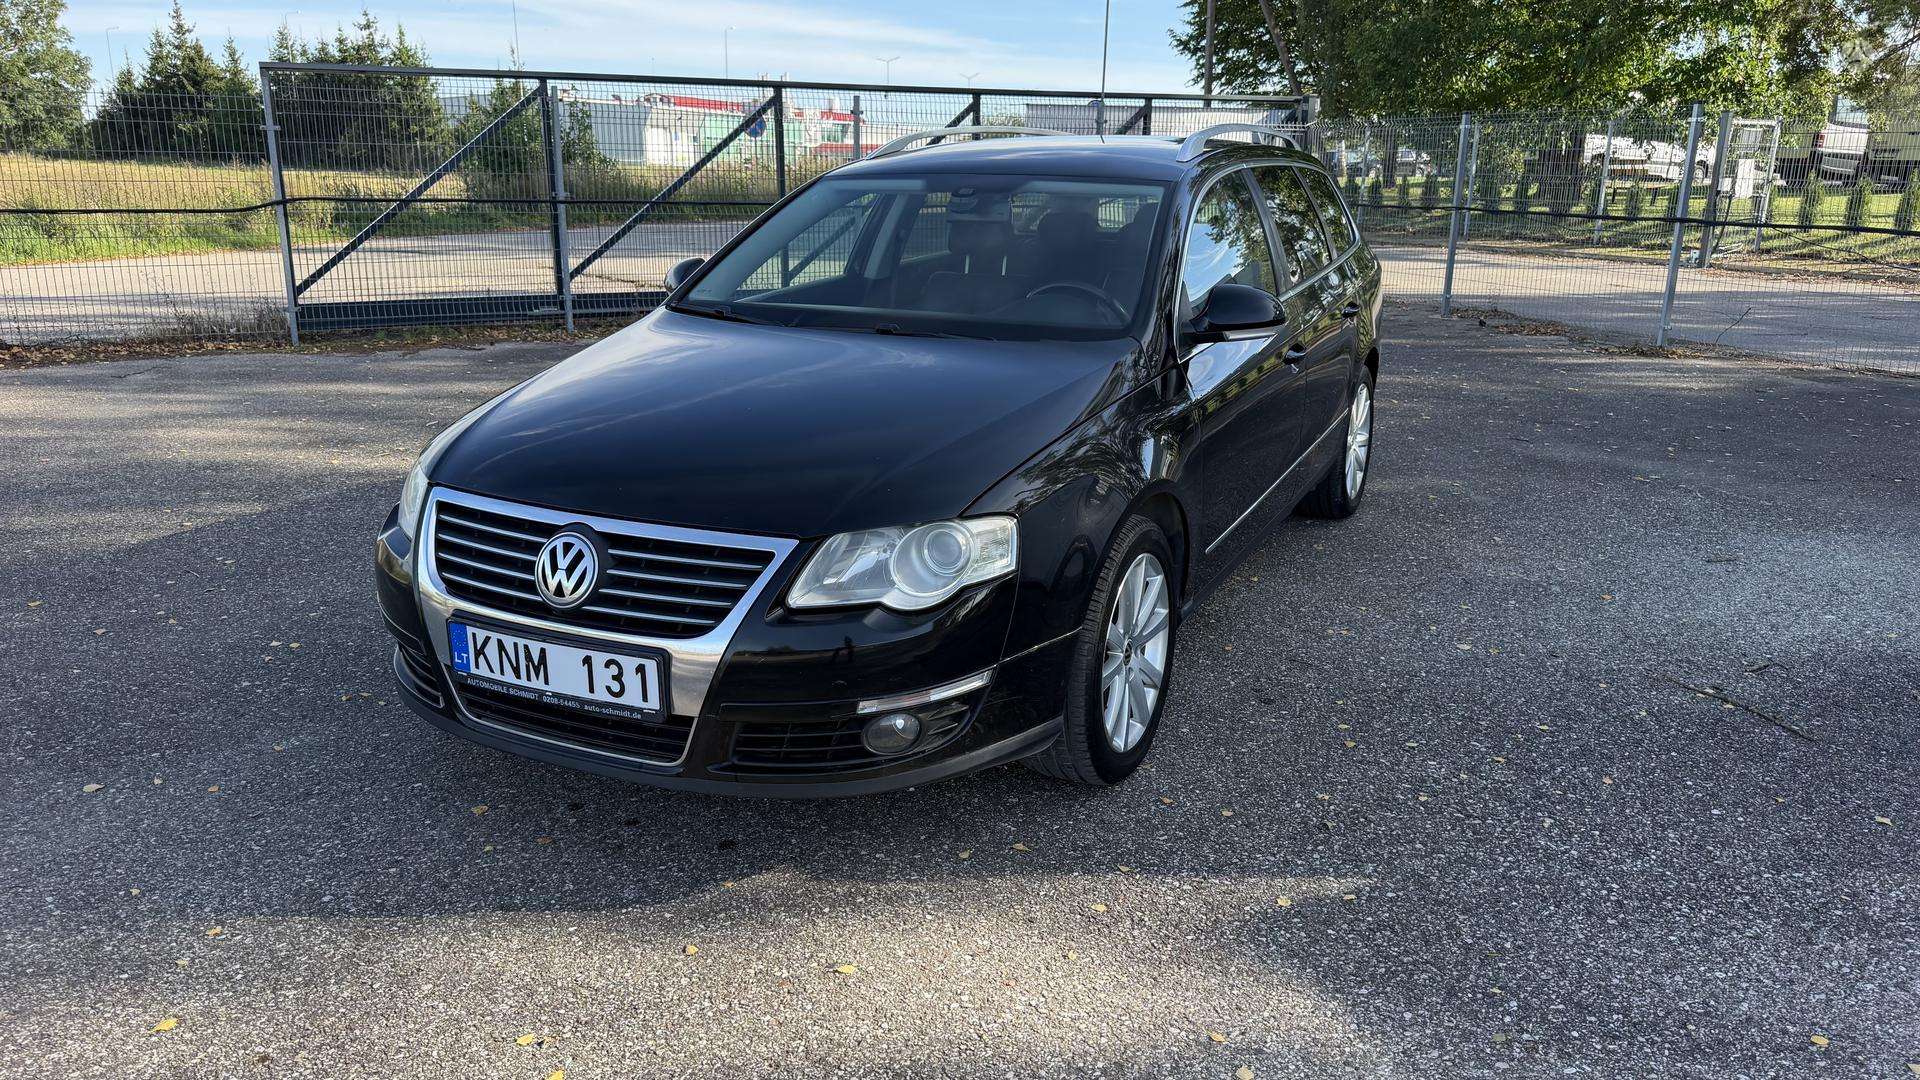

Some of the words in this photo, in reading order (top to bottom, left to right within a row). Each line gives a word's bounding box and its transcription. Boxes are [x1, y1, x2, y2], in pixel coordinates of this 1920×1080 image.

[538, 536, 595, 603] VW
[454, 651, 469, 664] LT
[471, 632, 550, 685] KNM
[581, 655, 649, 703] 131
[467, 678, 508, 693] AUTOMOBILE
[509, 688, 539, 701] SCHMIDT
[584, 704, 642, 719] auto-schmidt.de
